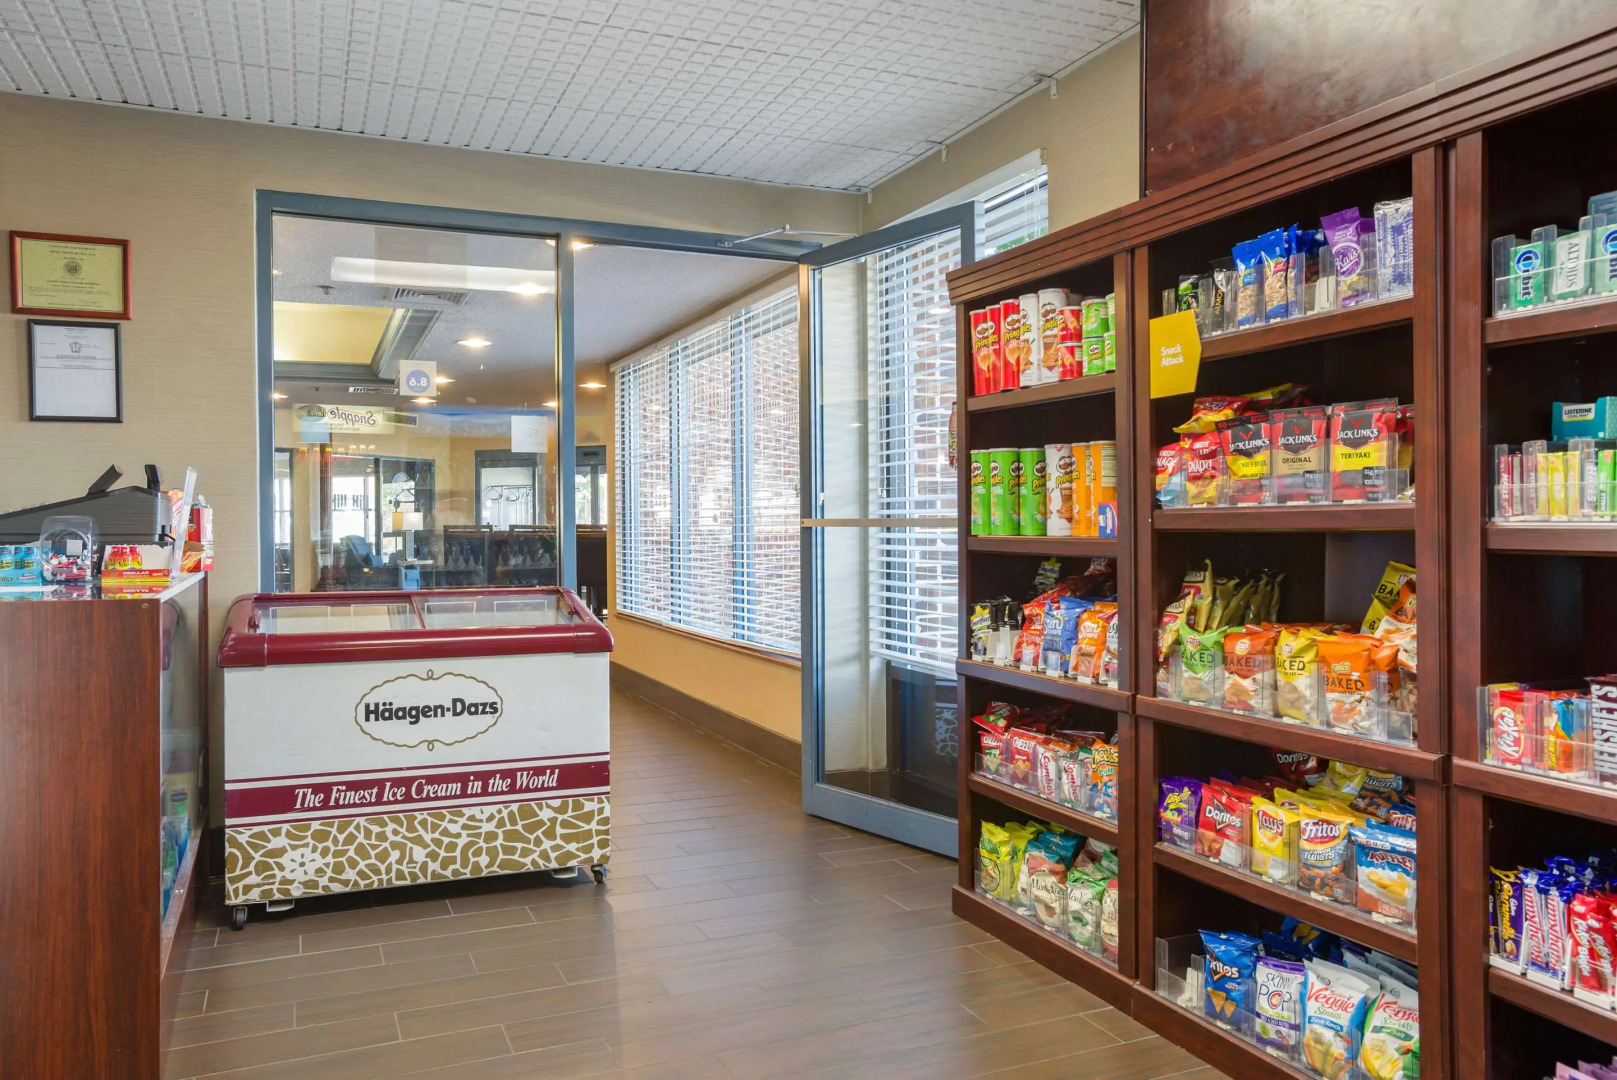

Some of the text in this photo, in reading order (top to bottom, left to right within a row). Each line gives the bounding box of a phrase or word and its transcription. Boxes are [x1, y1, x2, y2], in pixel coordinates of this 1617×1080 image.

[1565, 242, 1580, 289] ALTOIDS
[1215, 288, 1223, 315] ALMON
[1161, 344, 1182, 356] Snack
[1161, 354, 1184, 366] Attack
[1278, 434, 1318, 446] JACK LINK'S
[1336, 428, 1379, 439] JACK LINK'S
[1229, 438, 1270, 452] JACK LINK'S
[1282, 456, 1312, 464] ORIGINAL
[1324, 676, 1365, 690] BAKED
[364, 697, 499, 725] Häagen-Dazs
[1591, 684, 1617, 775] HERSHEY'S
[294, 769, 560, 809] The Finest Ice Cream in the World
[1205, 805, 1242, 828] Doritos
[1302, 819, 1341, 840] Fritos
[1305, 851, 1336, 861] TWISTS
[1368, 850, 1415, 874] RUFFLES
[1257, 984, 1293, 1011] POP
[1307, 982, 1355, 1013] Veggie
[1314, 1006, 1342, 1020] Straws
[1310, 1016, 1341, 1030] Zesty Ranch
[1391, 1028, 1406, 1039] Salt
